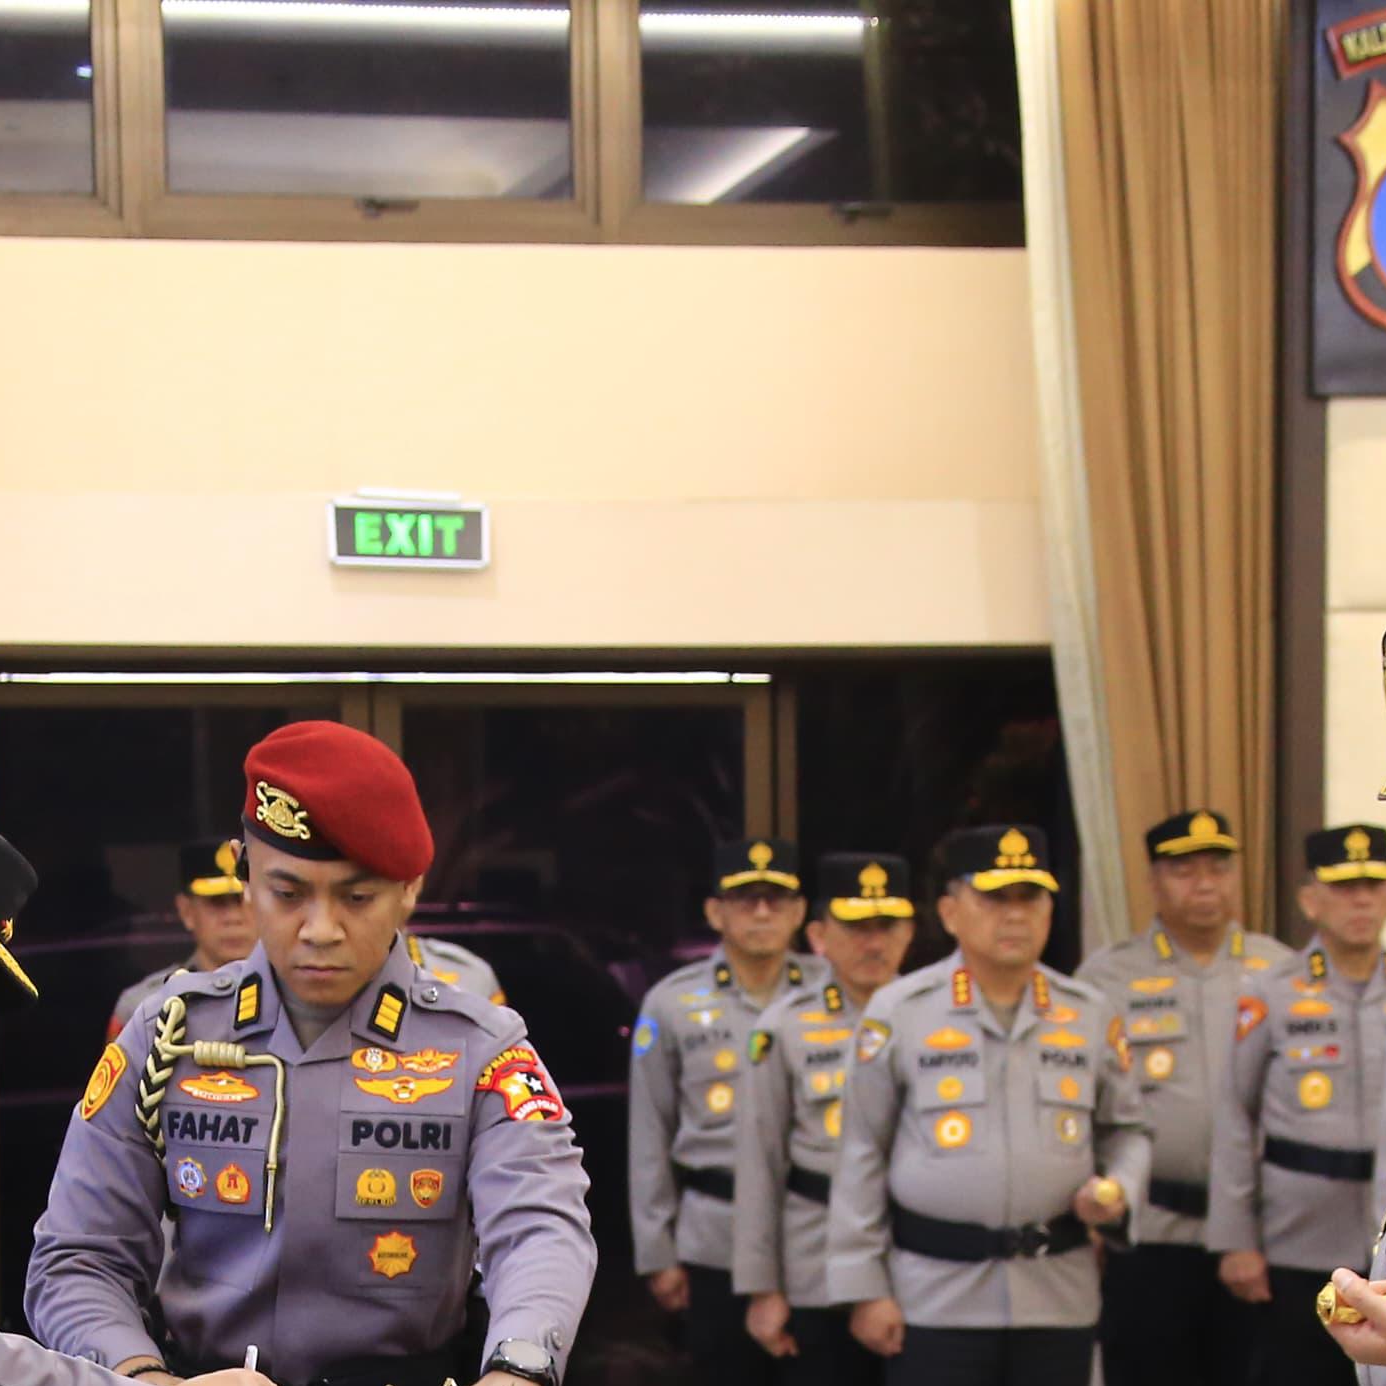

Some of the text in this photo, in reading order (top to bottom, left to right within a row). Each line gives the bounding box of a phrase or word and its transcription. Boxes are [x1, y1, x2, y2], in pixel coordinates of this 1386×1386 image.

[354, 511, 465, 557] EXIT
[167, 1111, 259, 1144] FAHAT
[351, 1119, 452, 1150] POLRI
